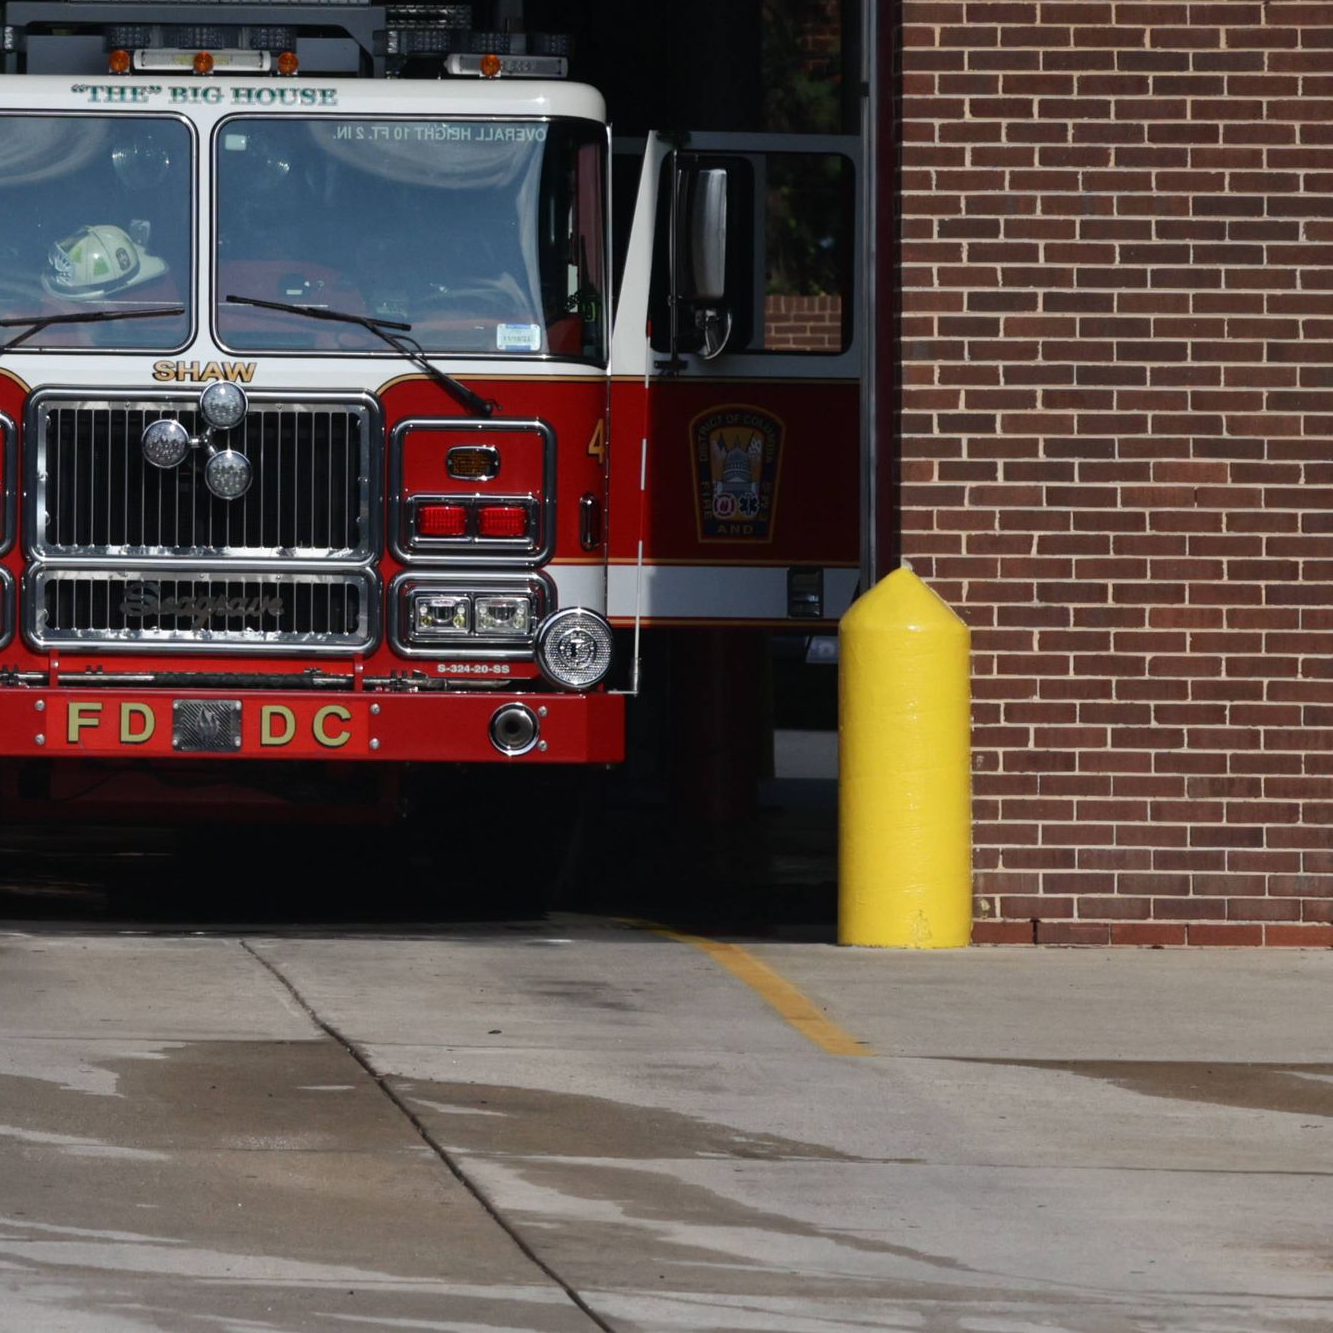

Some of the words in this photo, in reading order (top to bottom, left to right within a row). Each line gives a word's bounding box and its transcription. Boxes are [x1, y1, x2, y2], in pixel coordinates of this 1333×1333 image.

[167, 85, 224, 105] BIG
[230, 86, 338, 107] HOUSE
[152, 360, 257, 382] SHAW
[587, 417, 605, 465] 4
[716, 524, 754, 534] AND
[119, 582, 285, 631] Seagrave
[436, 664, 510, 674] S-324-20-SS
